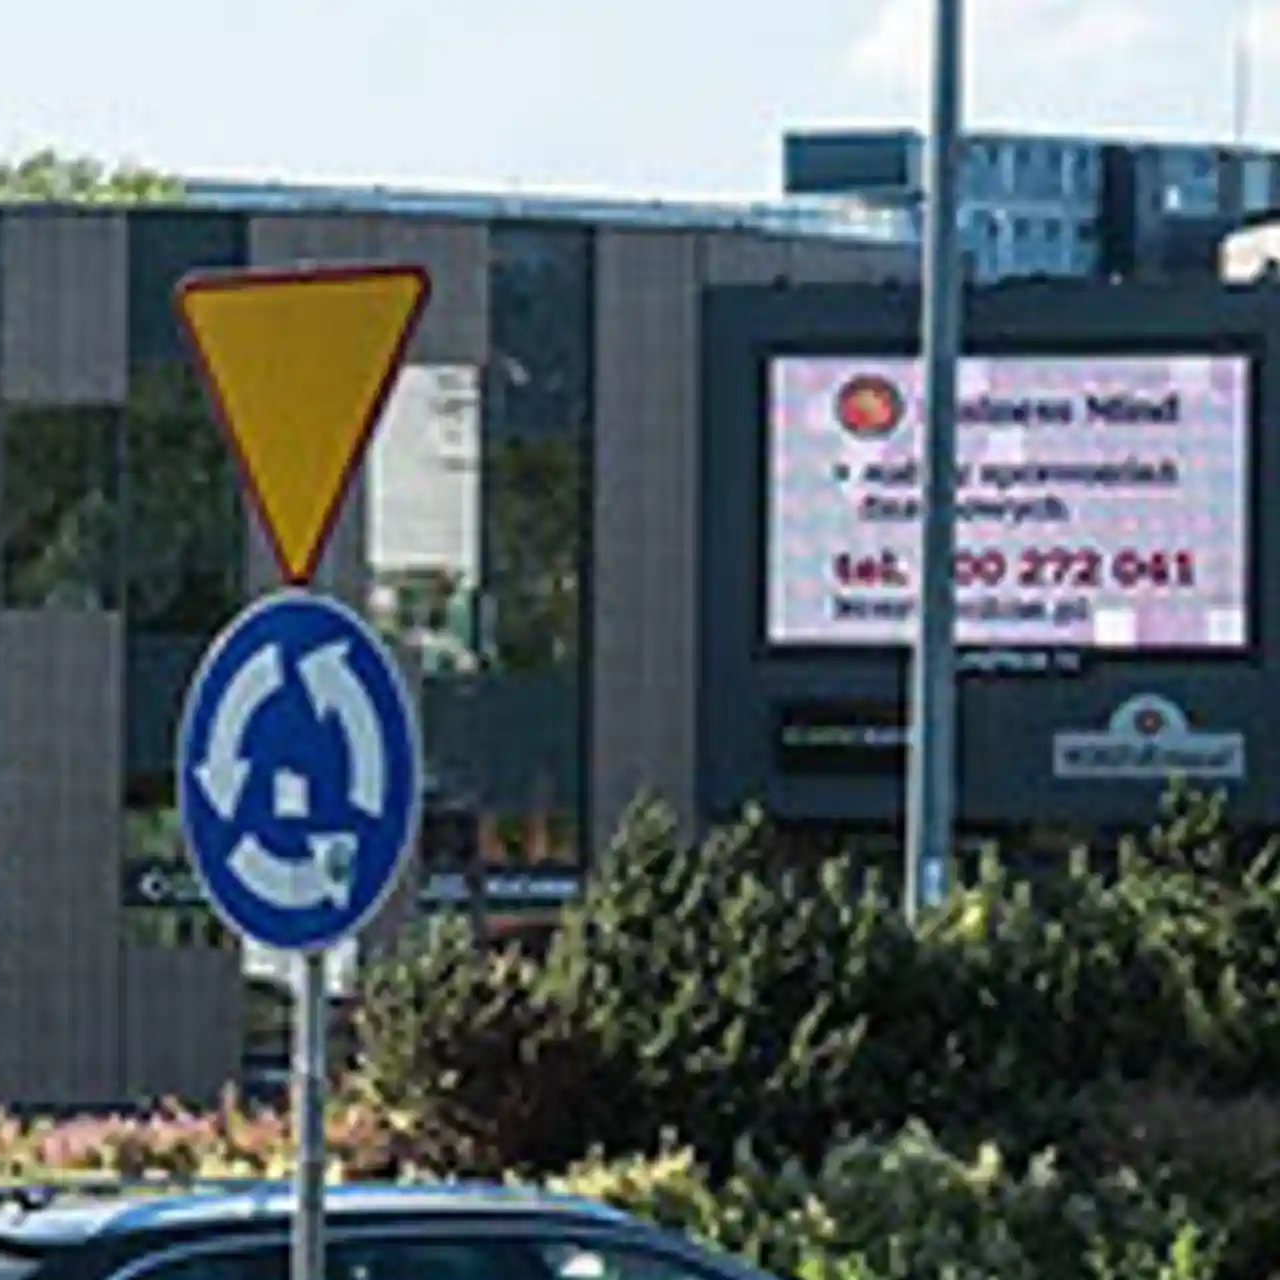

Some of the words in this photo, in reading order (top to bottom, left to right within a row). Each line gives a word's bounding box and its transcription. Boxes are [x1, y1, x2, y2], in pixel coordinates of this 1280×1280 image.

[1085, 394, 1179, 423] Mind
[952, 548, 1006, 587] 00
[1019, 547, 1102, 588] 272
